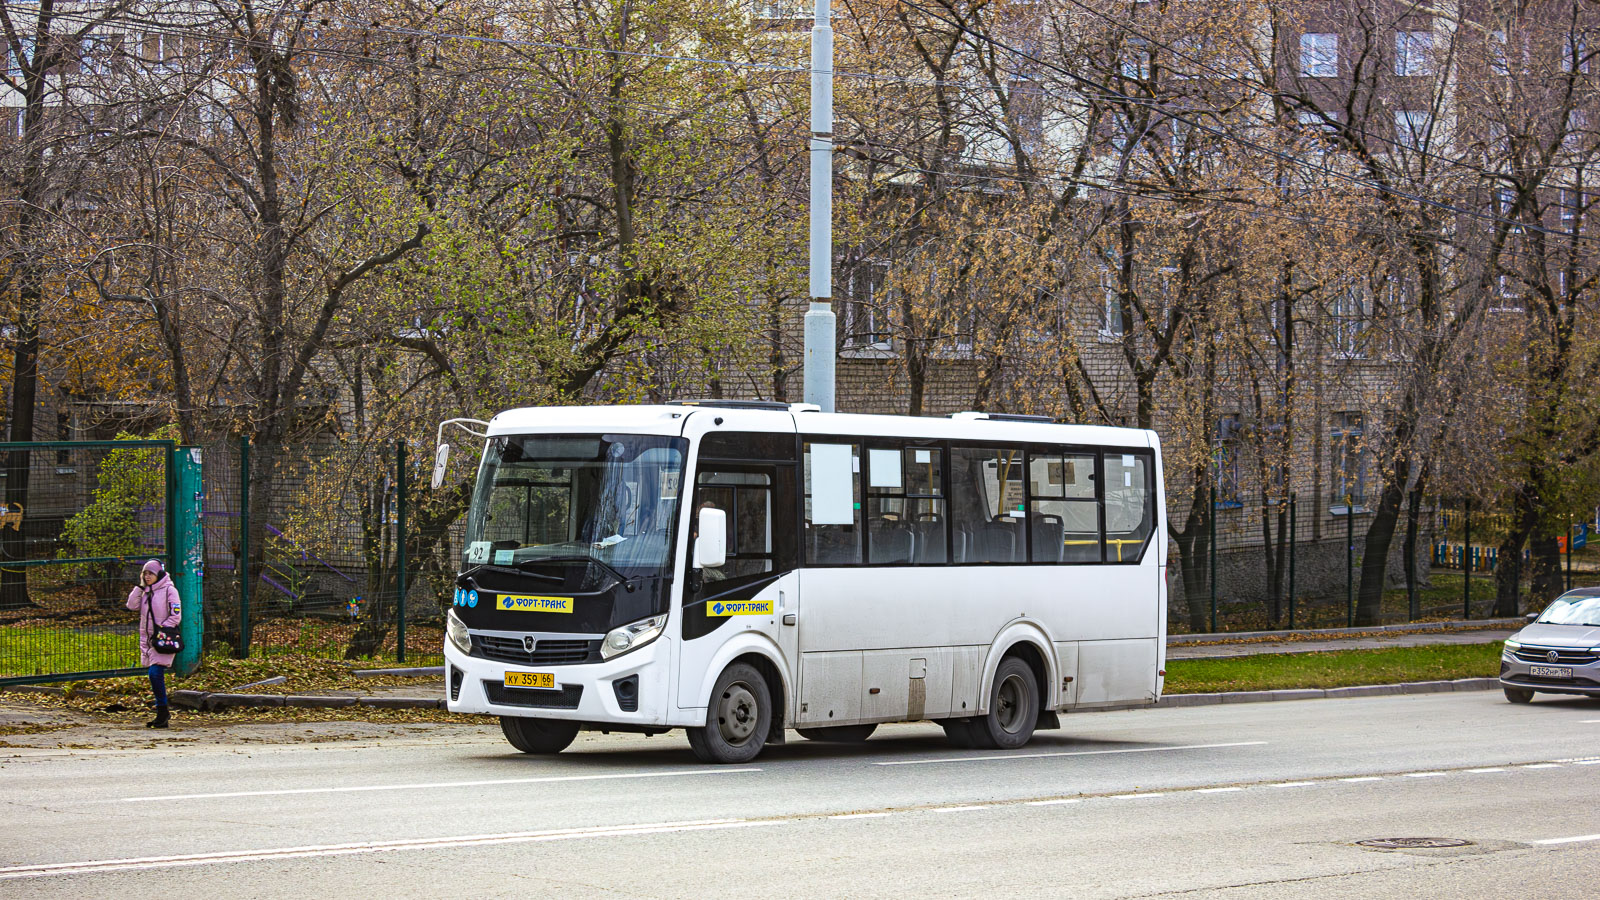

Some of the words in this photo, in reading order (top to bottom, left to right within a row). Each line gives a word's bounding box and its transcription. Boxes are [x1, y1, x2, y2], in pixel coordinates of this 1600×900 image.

[473, 546, 484, 561] 92
[515, 598, 567, 610] ФОРТ-ТРАНС
[725, 602, 769, 613] ФОРТ-ТРАНС
[521, 673, 538, 686] 359
[542, 674, 552, 683] 66
